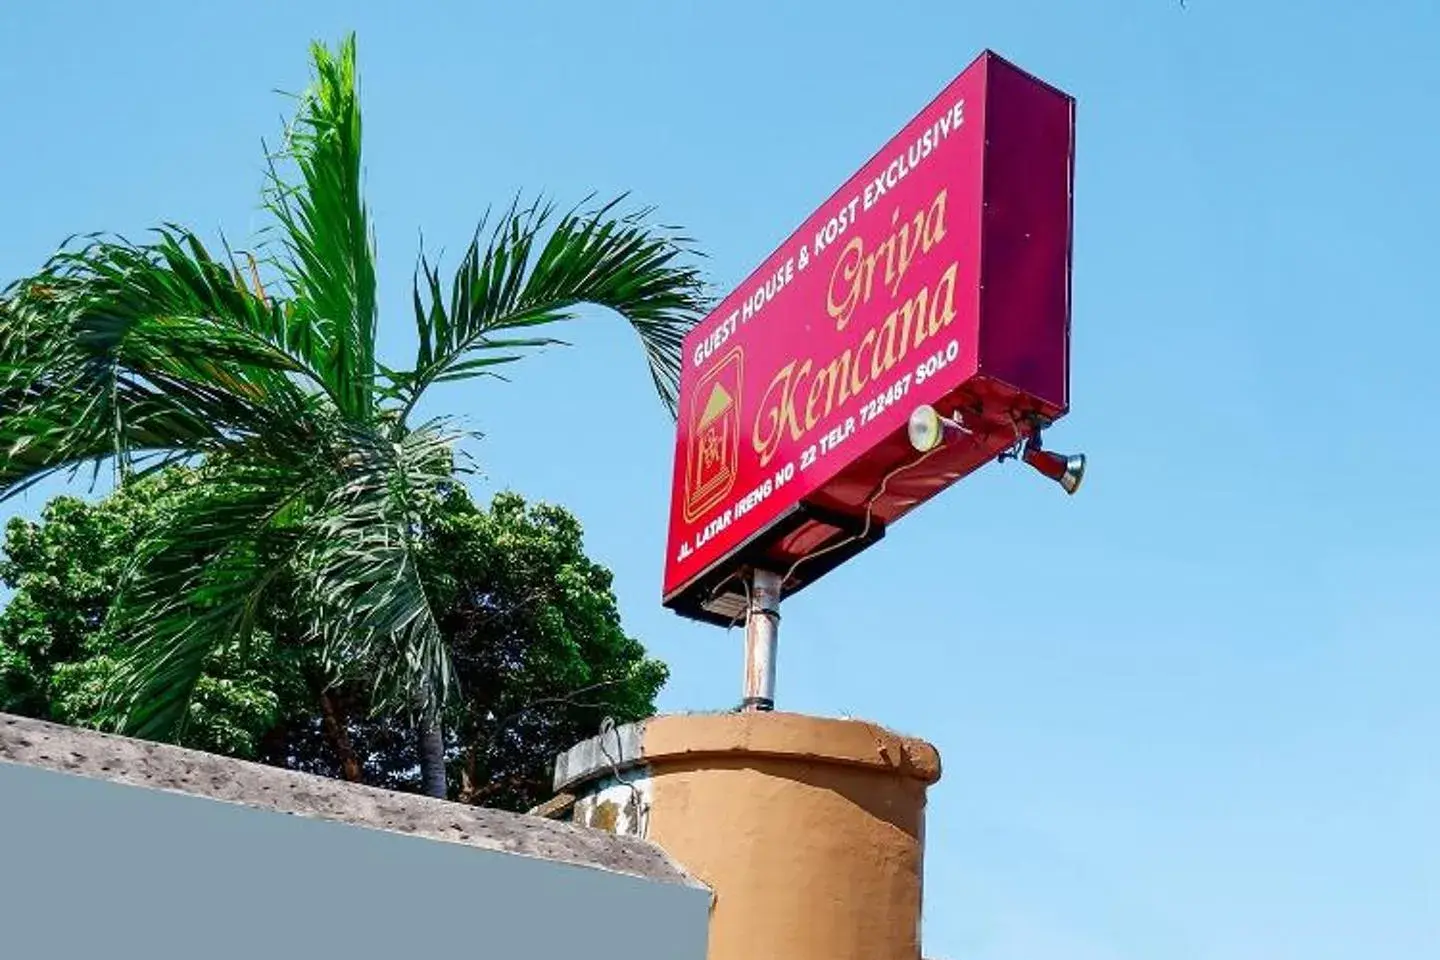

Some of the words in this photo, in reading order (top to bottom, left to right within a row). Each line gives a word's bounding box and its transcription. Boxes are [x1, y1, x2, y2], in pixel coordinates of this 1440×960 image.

[693, 309, 740, 367] GUEST
[742, 257, 794, 323] HOUSE
[798, 245, 809, 271] &
[813, 195, 859, 256] KOST
[862, 99, 965, 211] EXCLUSIVE
[696, 509, 732, 548] LATAR
[734, 478, 773, 520] IRENG
[800, 445, 817, 471] 22
[915, 339, 959, 384] SOLO
[752, 261, 959, 467] Kencana
